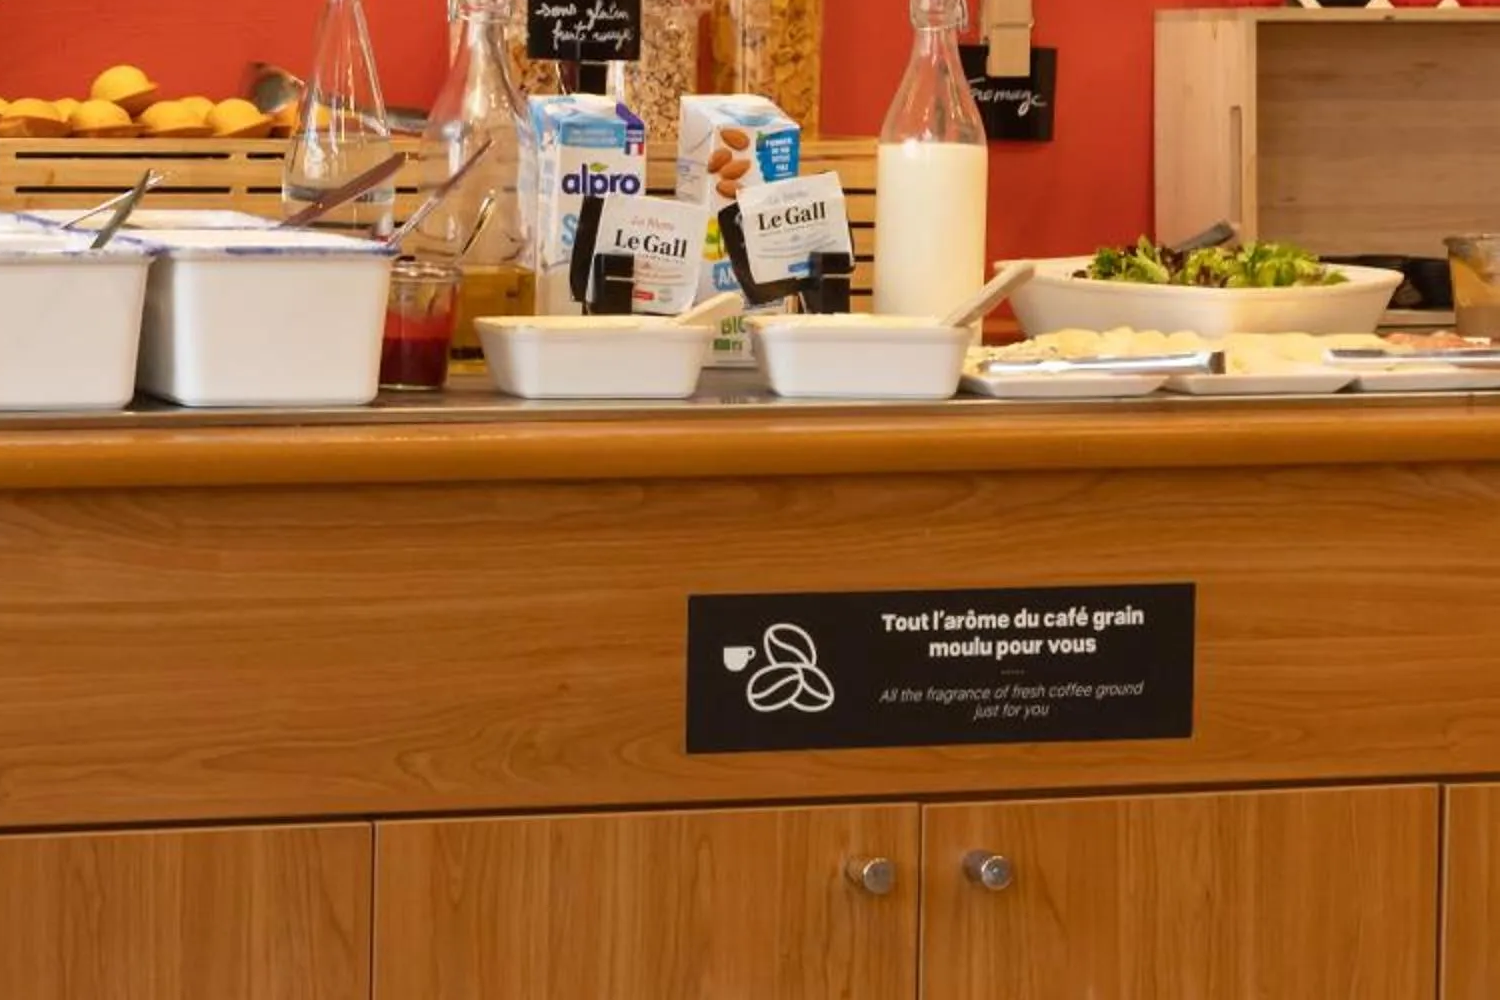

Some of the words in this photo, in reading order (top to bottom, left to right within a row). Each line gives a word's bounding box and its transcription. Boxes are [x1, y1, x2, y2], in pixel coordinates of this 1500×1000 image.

[561, 163, 641, 197] alpro
[758, 212, 782, 231] Le
[785, 201, 826, 225] Gall
[614, 229, 640, 250] Le
[643, 233, 687, 258] Gall
[881, 610, 929, 632] Tout
[933, 608, 1010, 630] l'arôme
[1013, 607, 1039, 628] du
[1043, 605, 1089, 627] café
[1093, 605, 1145, 631] grain
[928, 636, 993, 658] moulu
[996, 637, 1042, 660] pour
[1048, 636, 1097, 654] vous
[879, 687, 898, 702] All
[900, 687, 923, 702] the
[926, 686, 991, 705] fragrance
[994, 684, 1009, 700] of
[1010, 683, 1046, 700] fresh
[1049, 681, 1093, 698] coffee
[1095, 680, 1146, 700] ground
[972, 703, 999, 720] just
[1002, 702, 1023, 718] for
[1022, 703, 1050, 720] you
